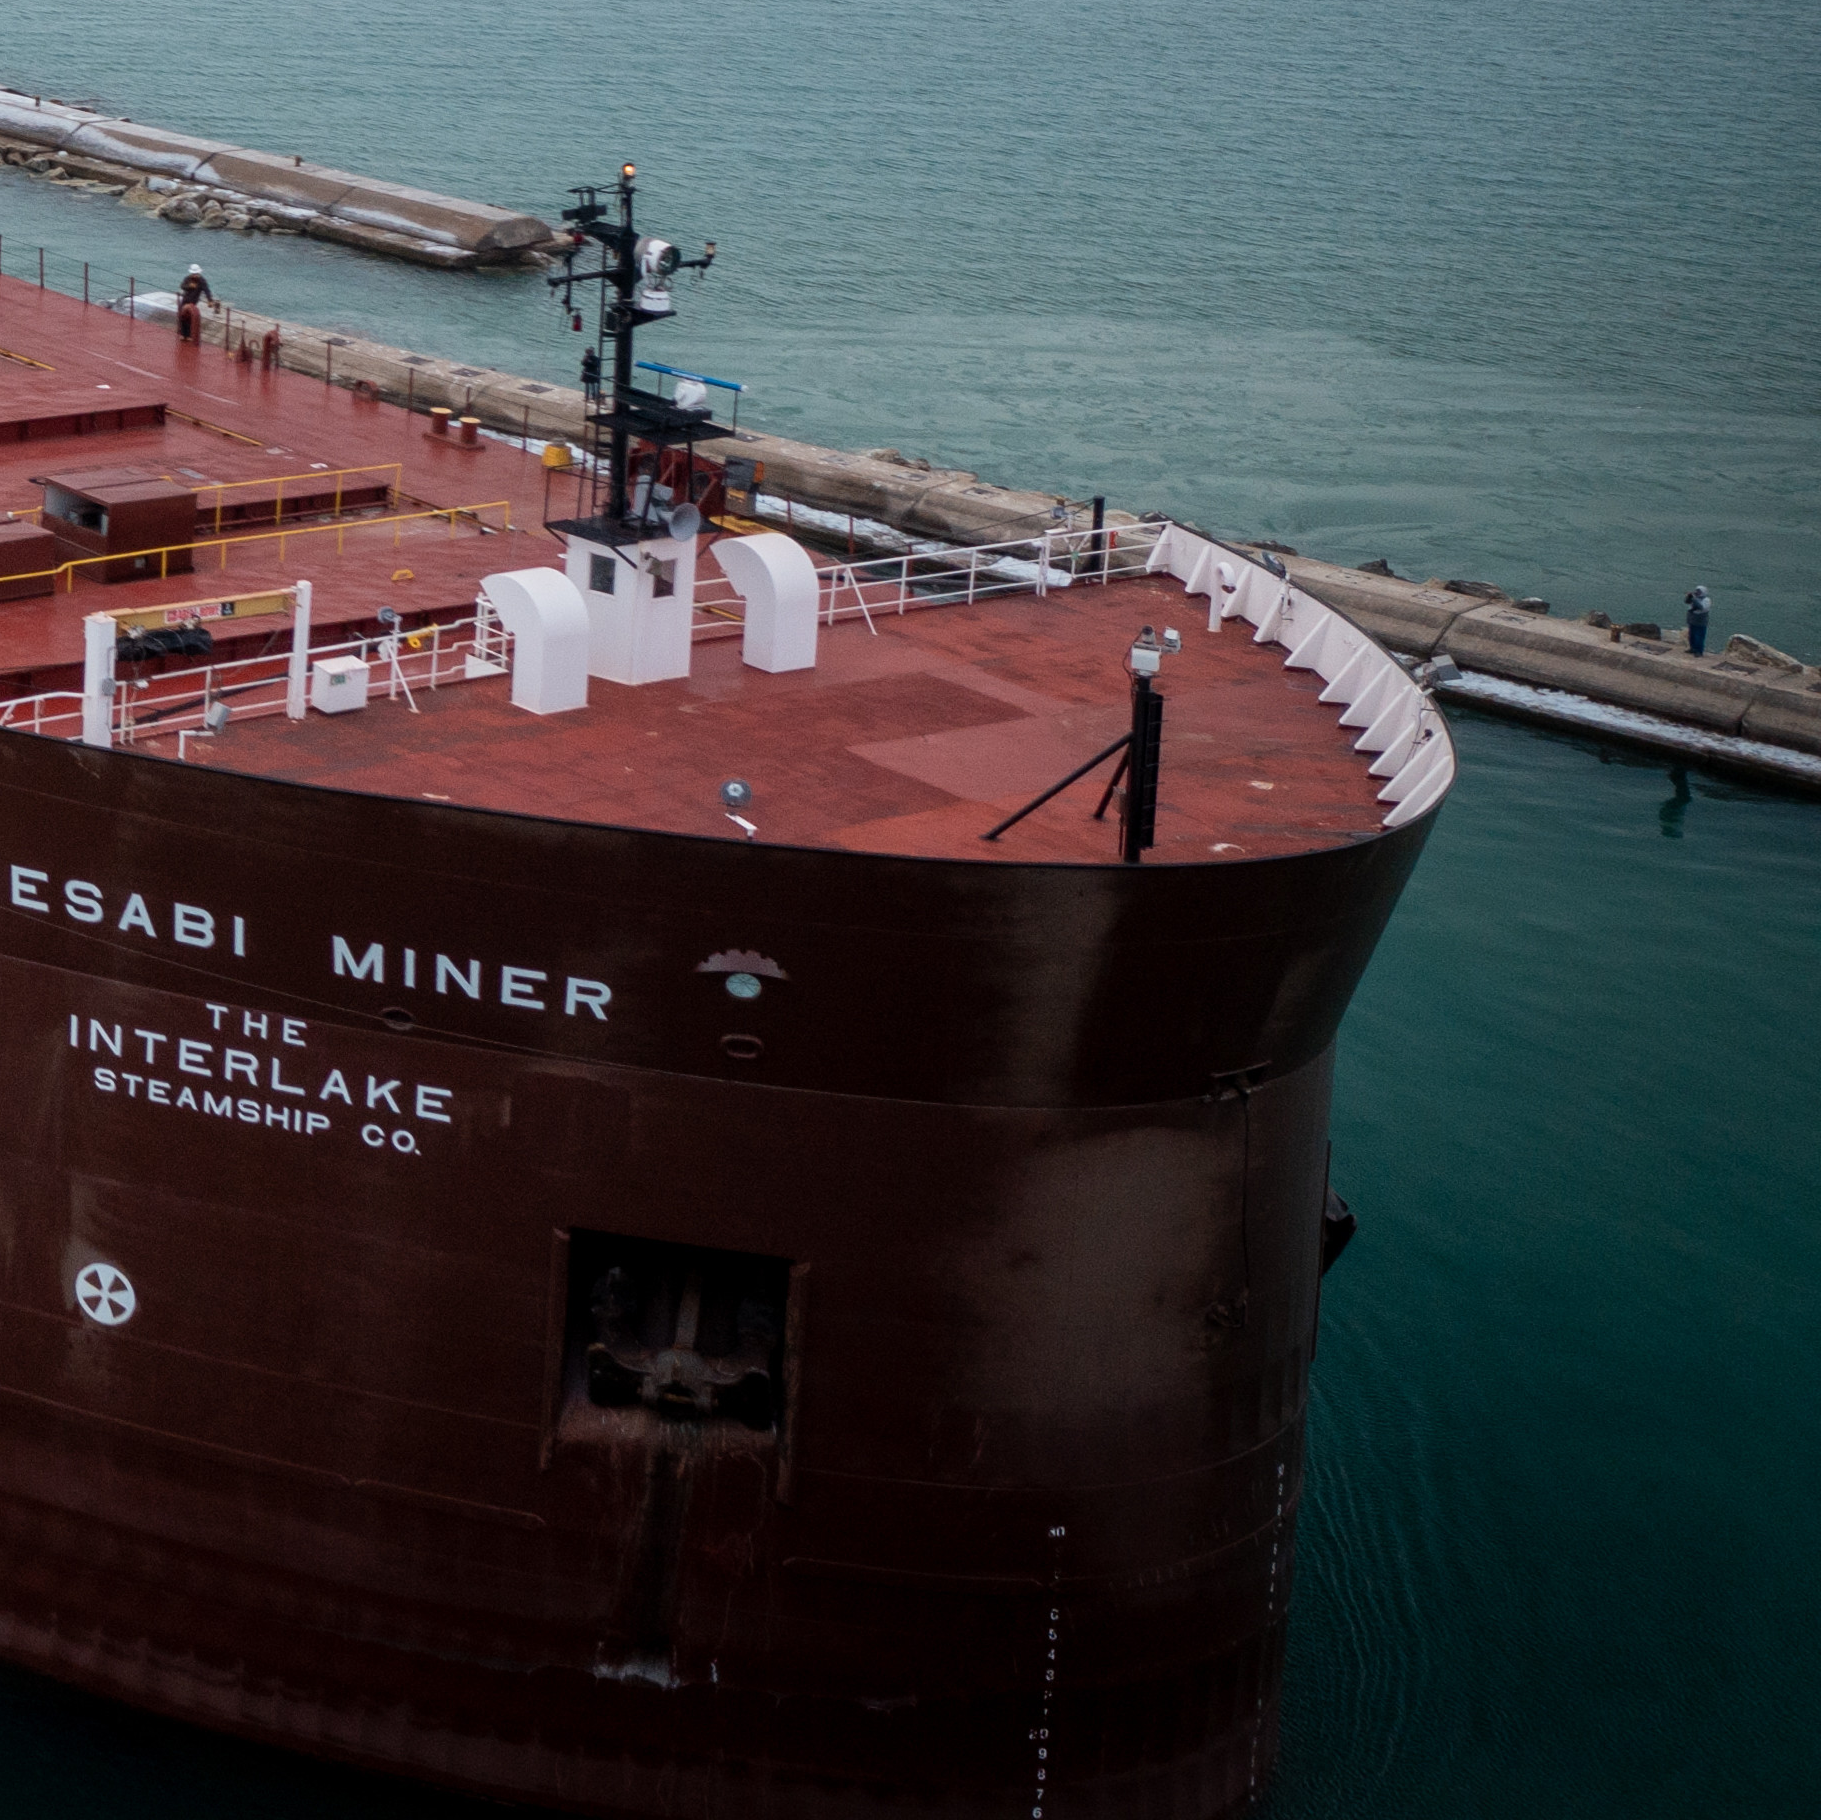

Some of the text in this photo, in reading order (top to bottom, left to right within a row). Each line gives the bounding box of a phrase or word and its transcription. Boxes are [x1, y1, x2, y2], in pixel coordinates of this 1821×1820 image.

[332, 935, 612, 1021] MINER
[70, 1013, 453, 1123] INTERLAKE
[205, 1002, 307, 1047] THE
[94, 1067, 421, 1157] STEAMSHIP CO.
